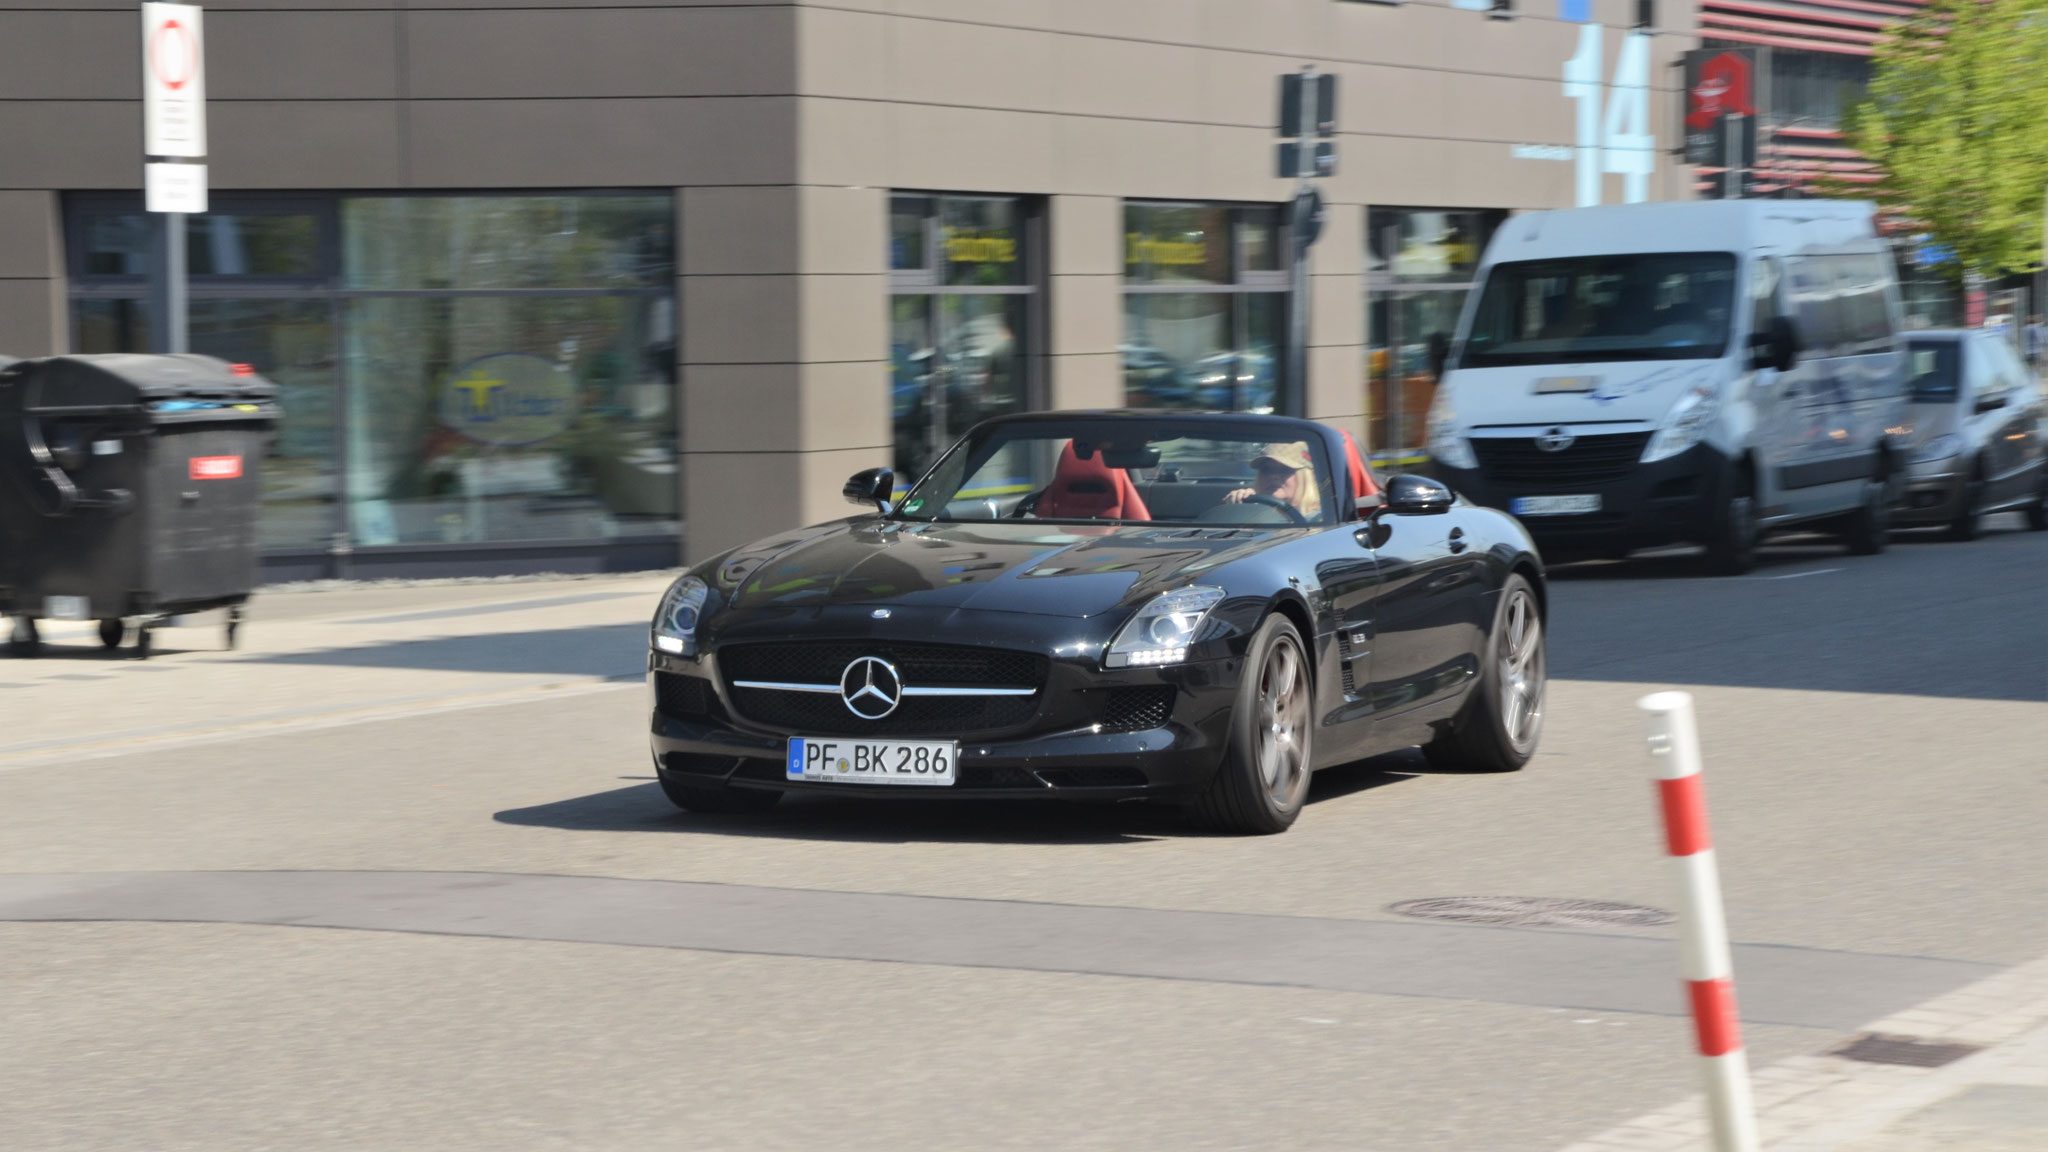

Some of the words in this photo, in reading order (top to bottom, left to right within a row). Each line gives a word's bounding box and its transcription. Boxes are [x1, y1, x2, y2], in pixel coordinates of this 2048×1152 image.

[1562, 23, 1655, 208] 14
[793, 759, 800, 769] D
[806, 743, 837, 771] PF
[854, 745, 888, 773] BK
[896, 746, 948, 774] 286
